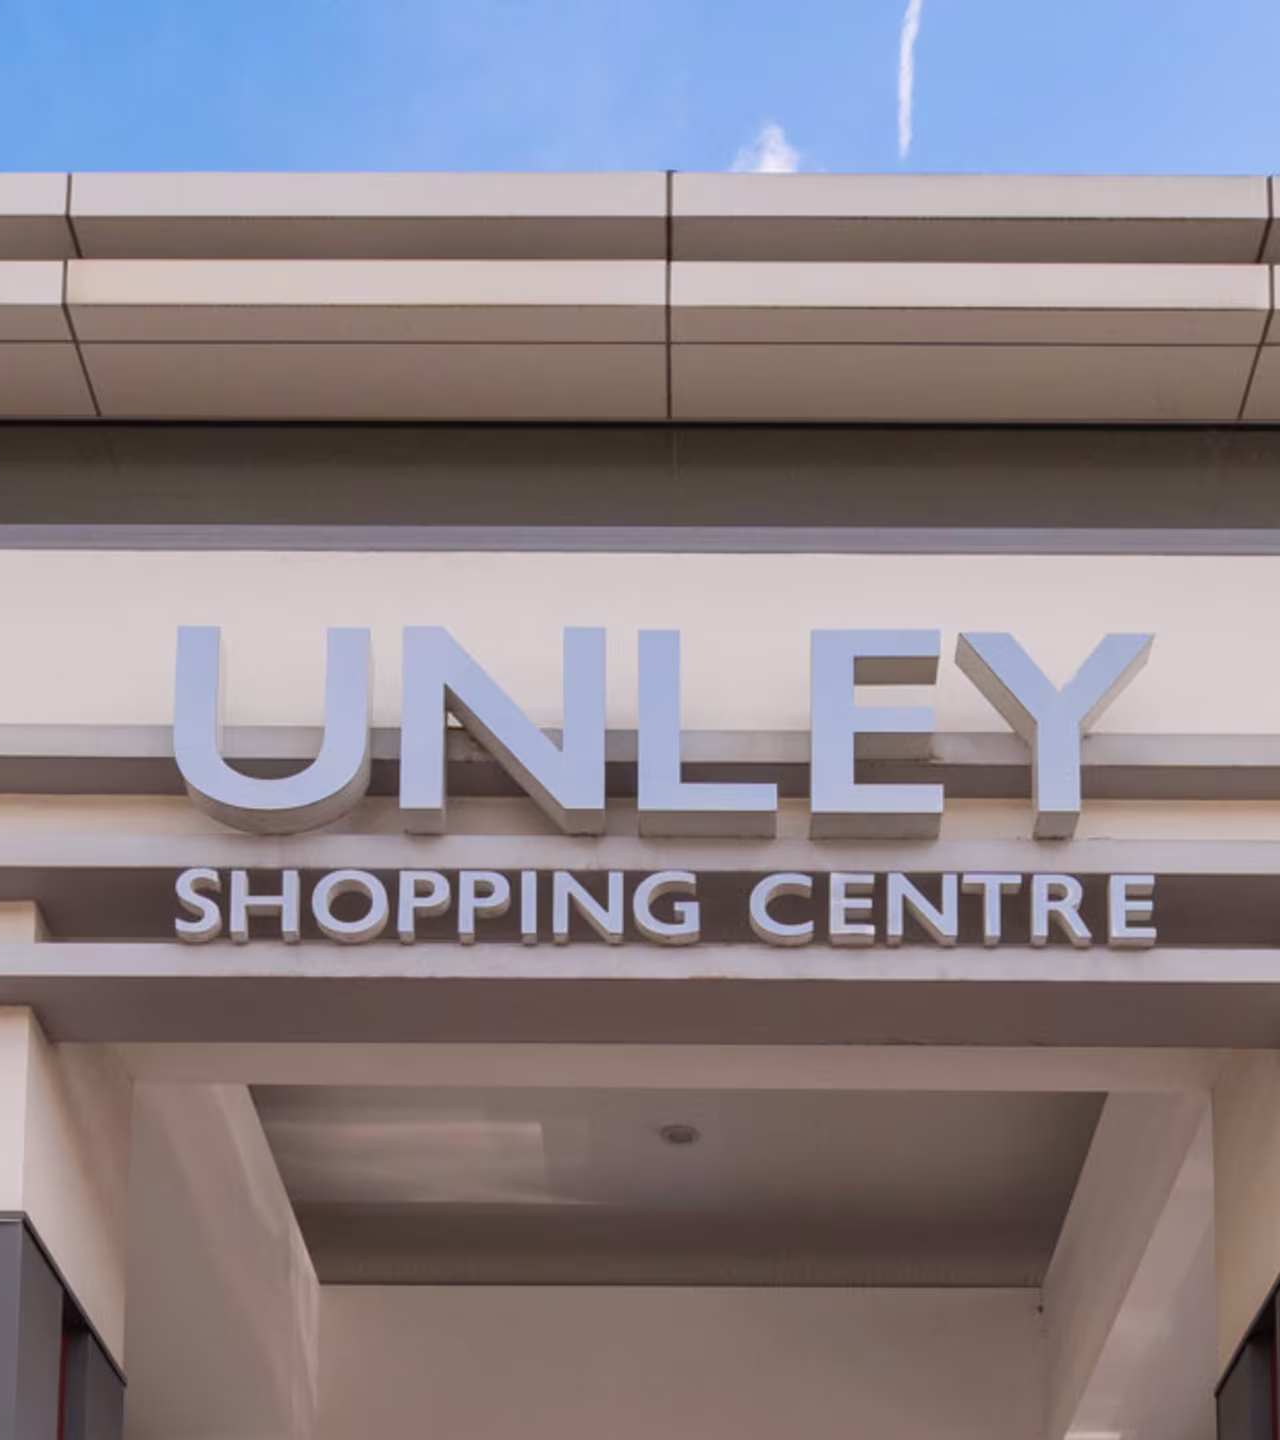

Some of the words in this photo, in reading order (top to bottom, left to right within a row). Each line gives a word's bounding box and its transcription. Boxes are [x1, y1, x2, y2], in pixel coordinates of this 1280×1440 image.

[173, 625, 1156, 838] UNLEY
[173, 867, 703, 946] SHOPPING
[748, 872, 1158, 951] CENTRE
